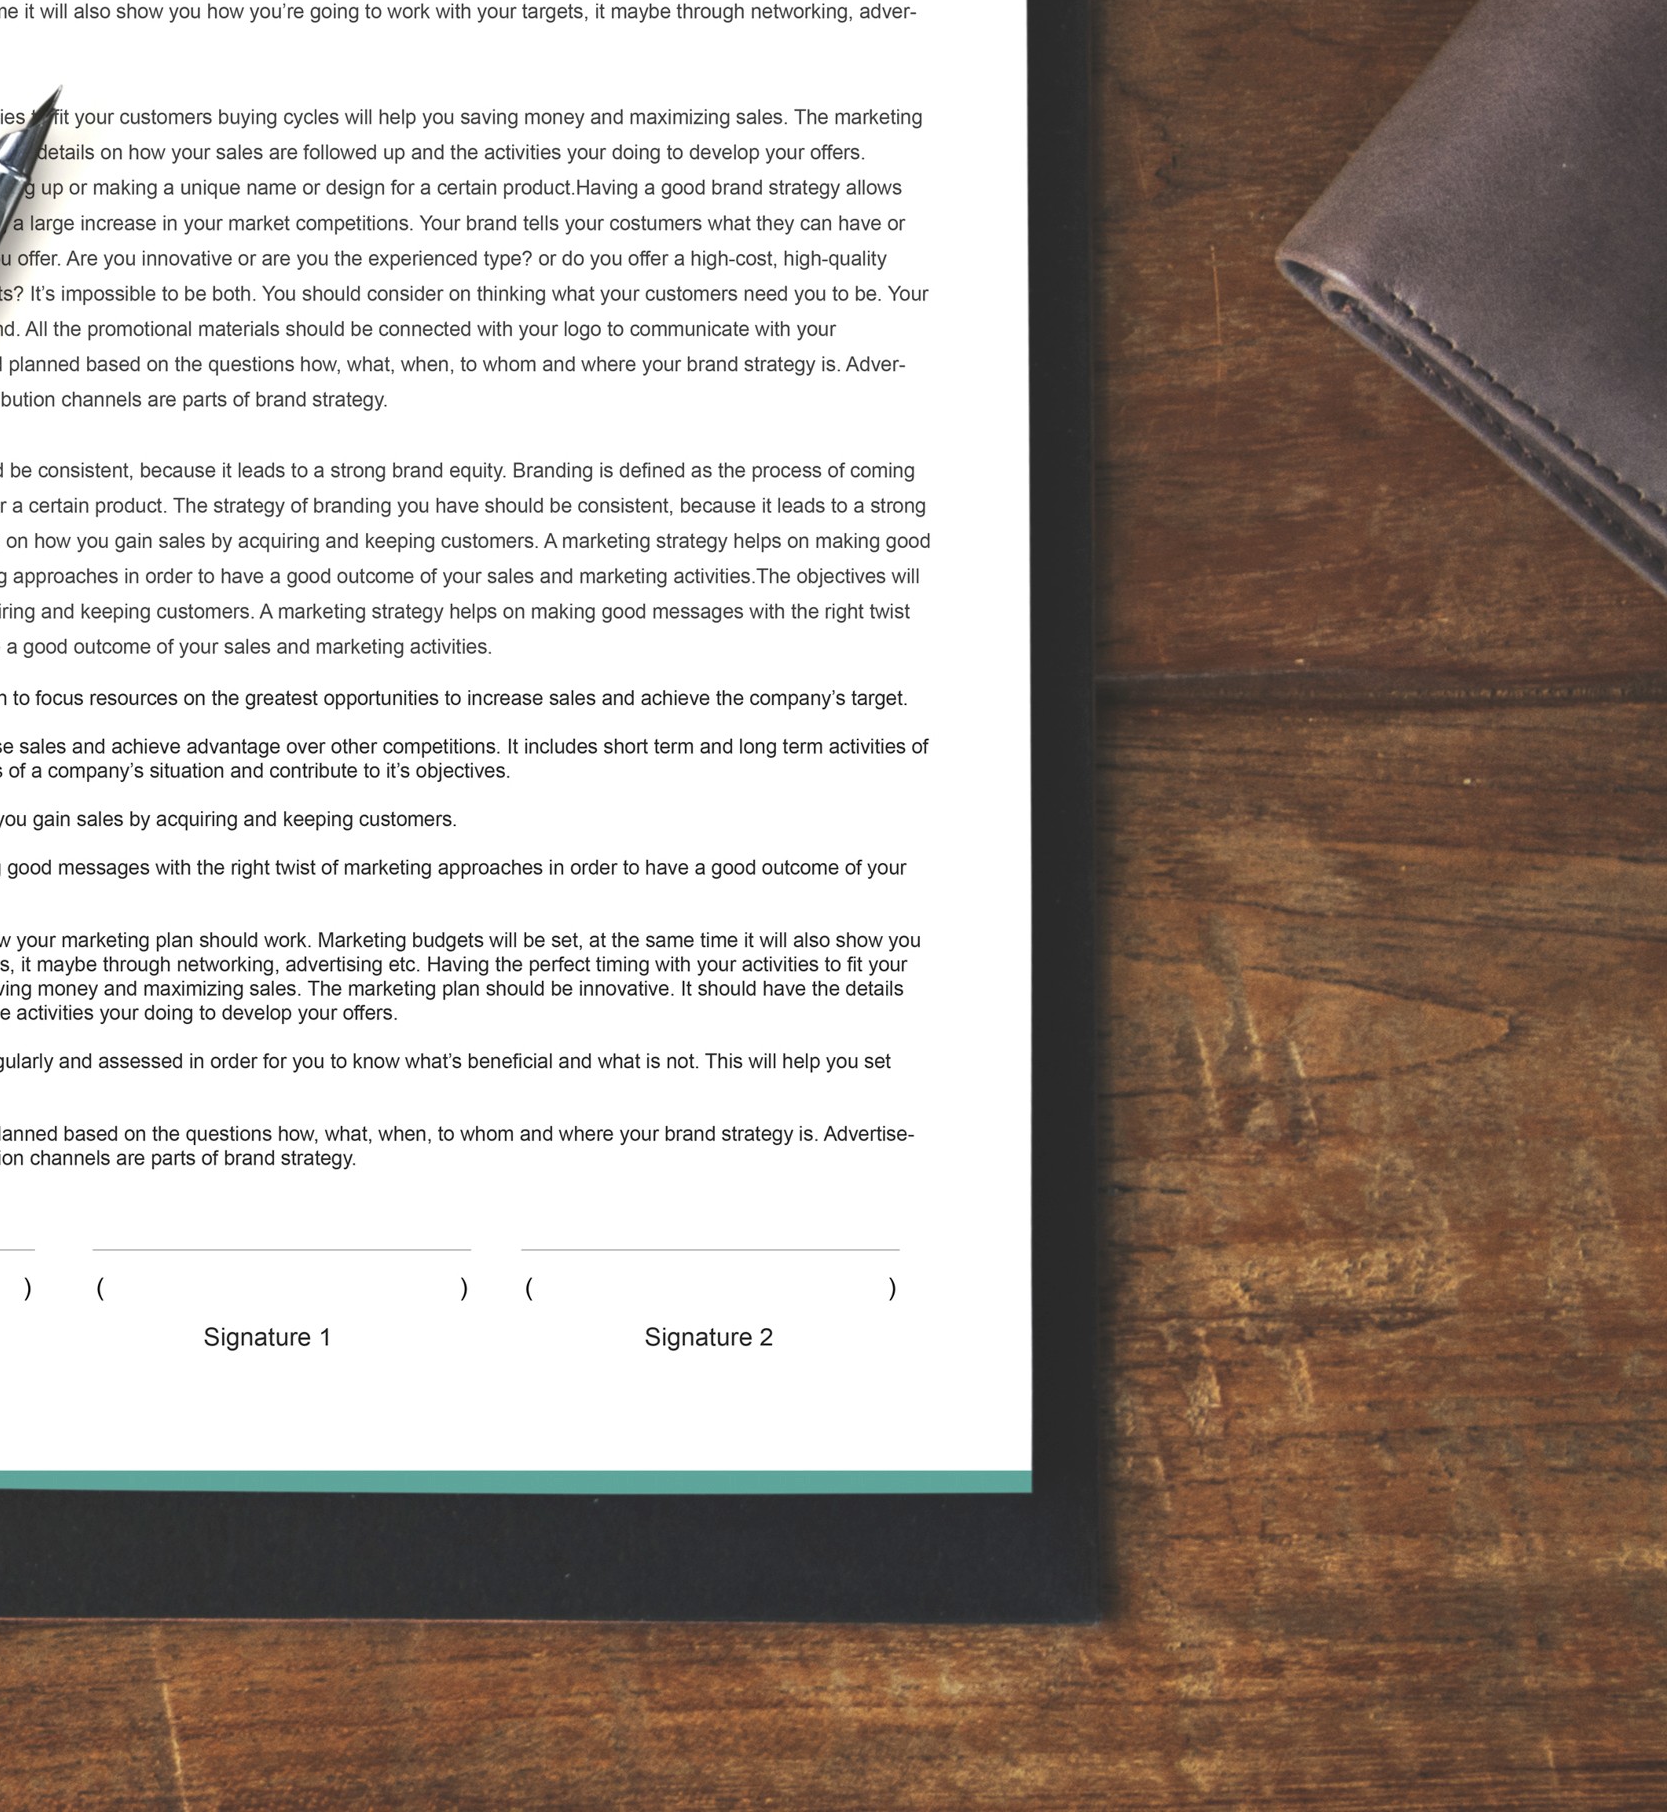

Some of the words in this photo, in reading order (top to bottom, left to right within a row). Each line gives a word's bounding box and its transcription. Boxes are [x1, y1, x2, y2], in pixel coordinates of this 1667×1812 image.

[34, 811, 69, 830] gain
[78, 812, 123, 826] sales
[131, 811, 150, 830] by
[157, 811, 237, 830] acquiring
[244, 811, 276, 826] and
[284, 811, 352, 830] keeping
[360, 812, 456, 826] customers.
[205, 1327, 310, 1351] Signature
[321, 1328, 328, 1346] 1
[646, 1327, 752, 1351] Signature
[760, 1328, 772, 1346] 2
